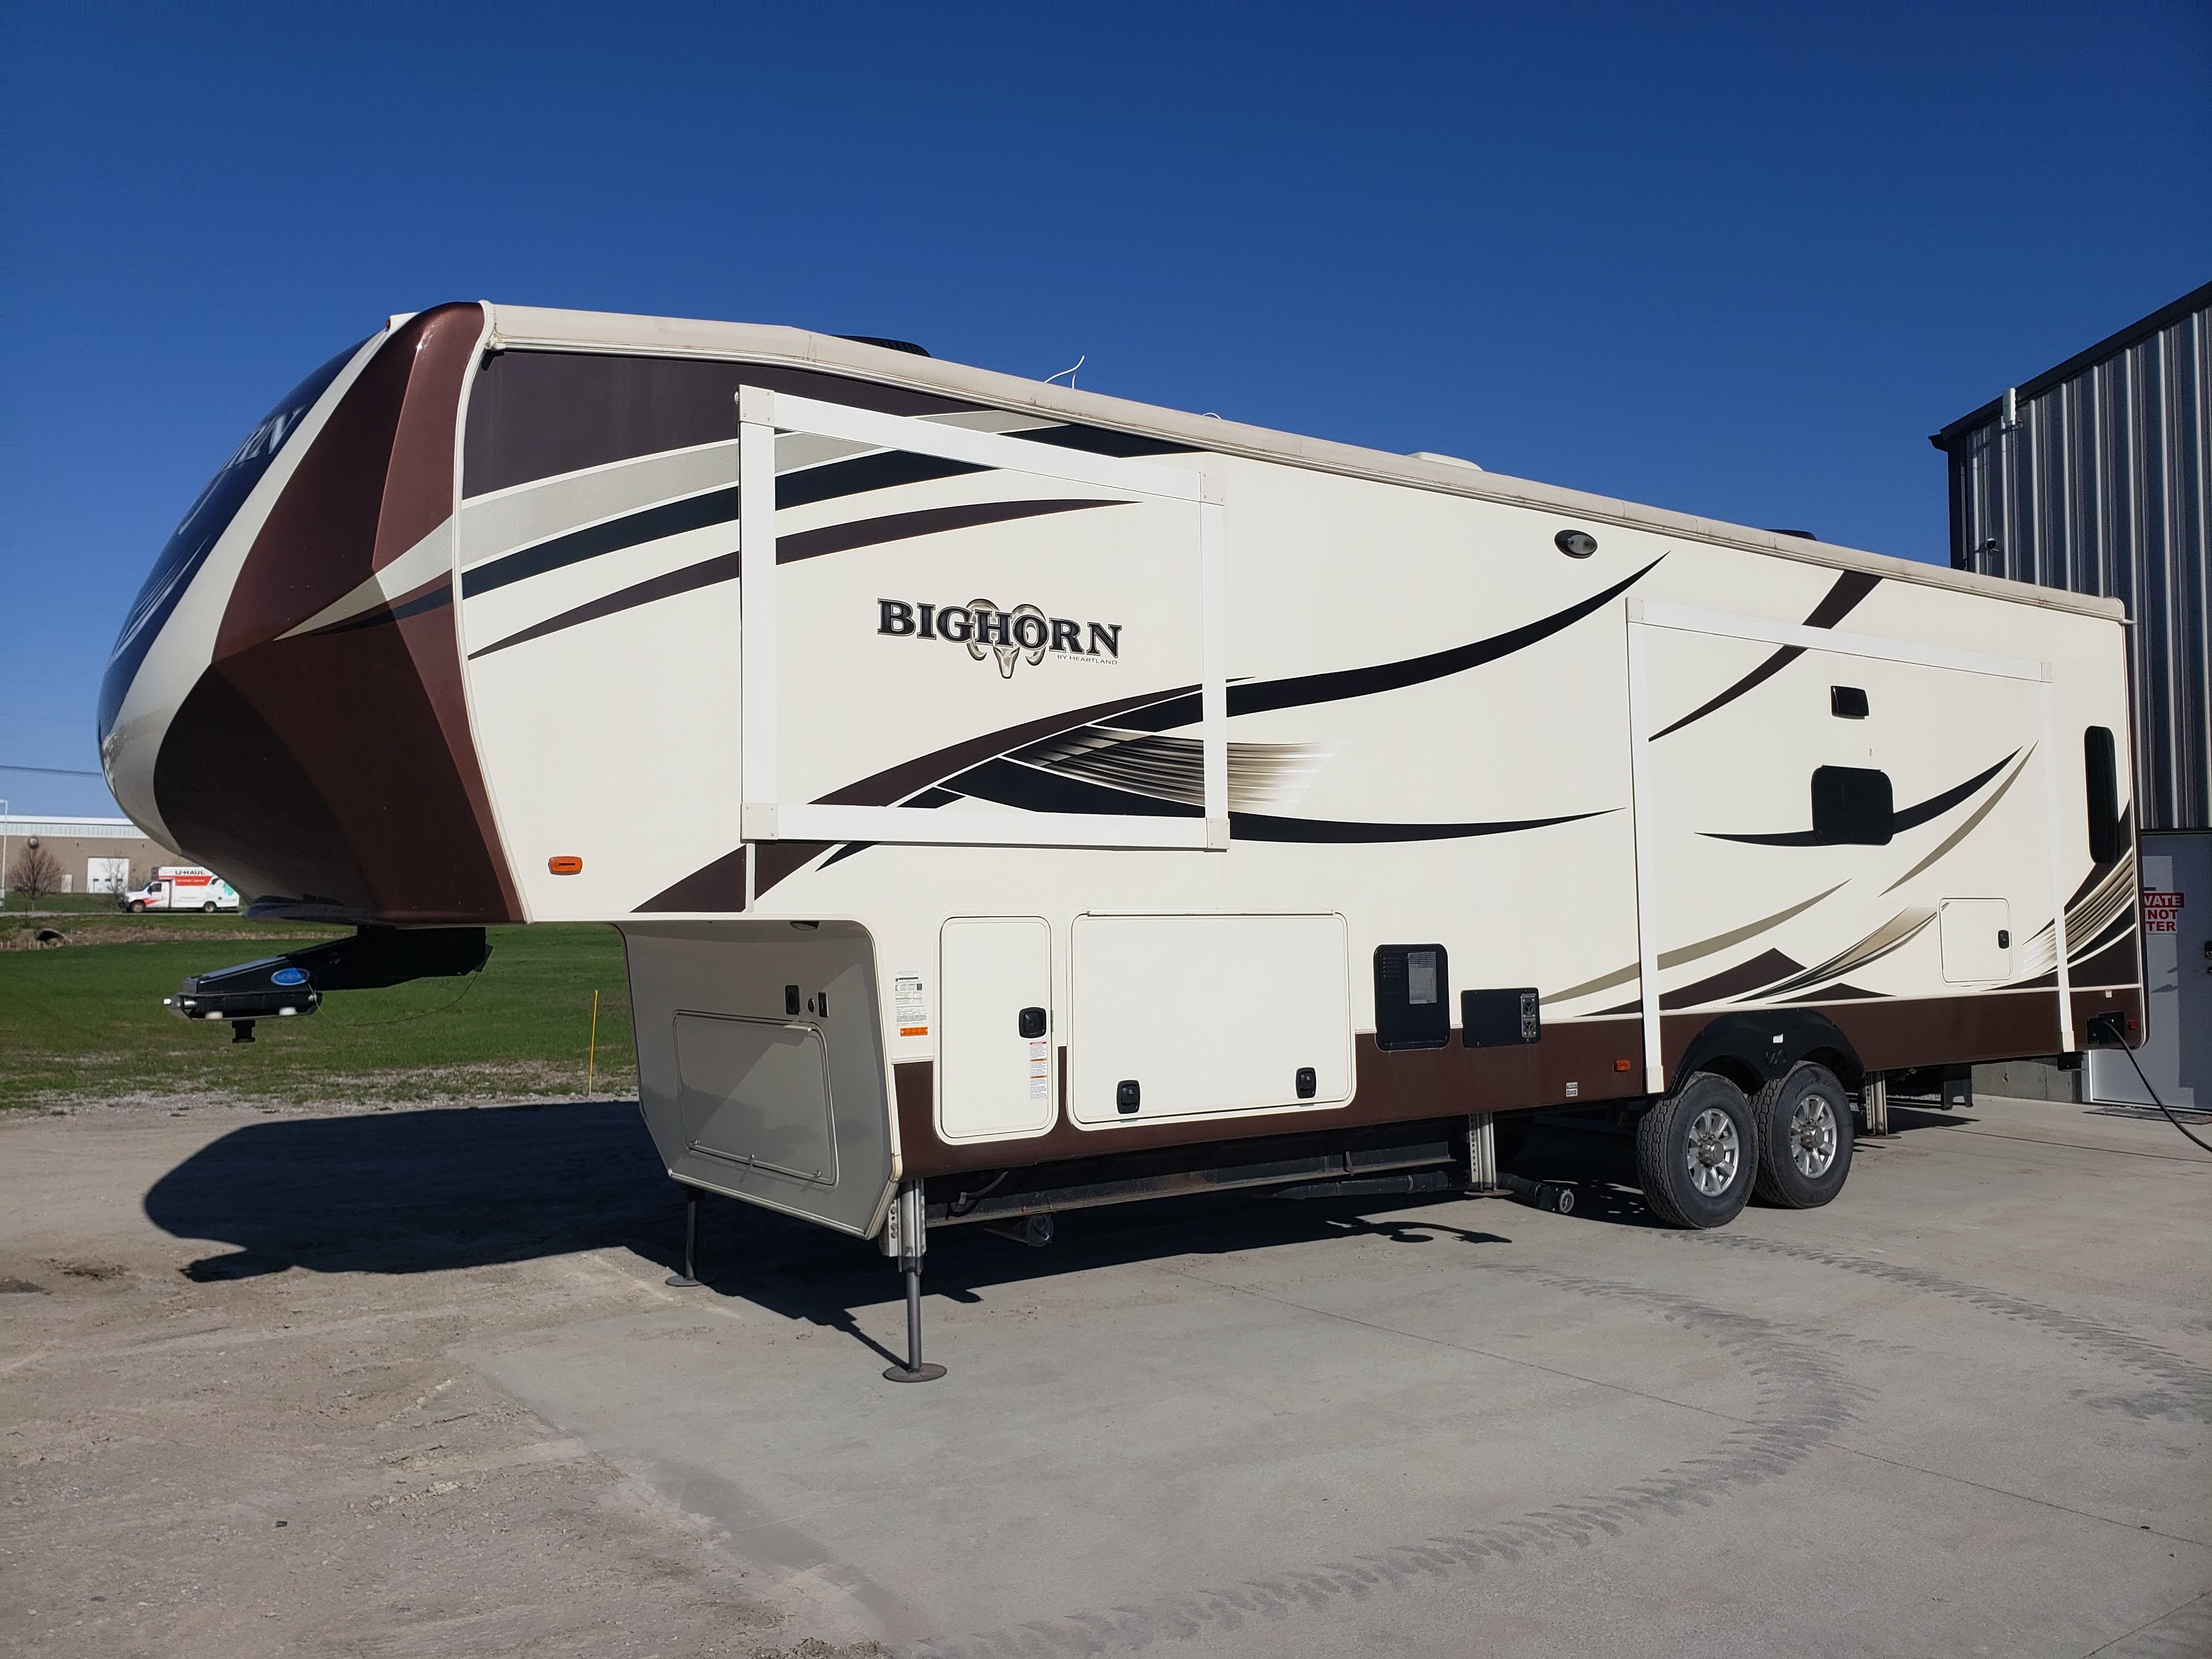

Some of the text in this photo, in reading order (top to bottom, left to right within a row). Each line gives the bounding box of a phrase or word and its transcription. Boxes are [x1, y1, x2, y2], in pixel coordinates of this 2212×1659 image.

[877, 597, 1122, 658] BIGHORN
[1069, 656, 1118, 665] HEARTLAND
[2145, 895, 2181, 906] VATE
[2147, 909, 2179, 919] NOT
[2146, 921, 2176, 932] TER
